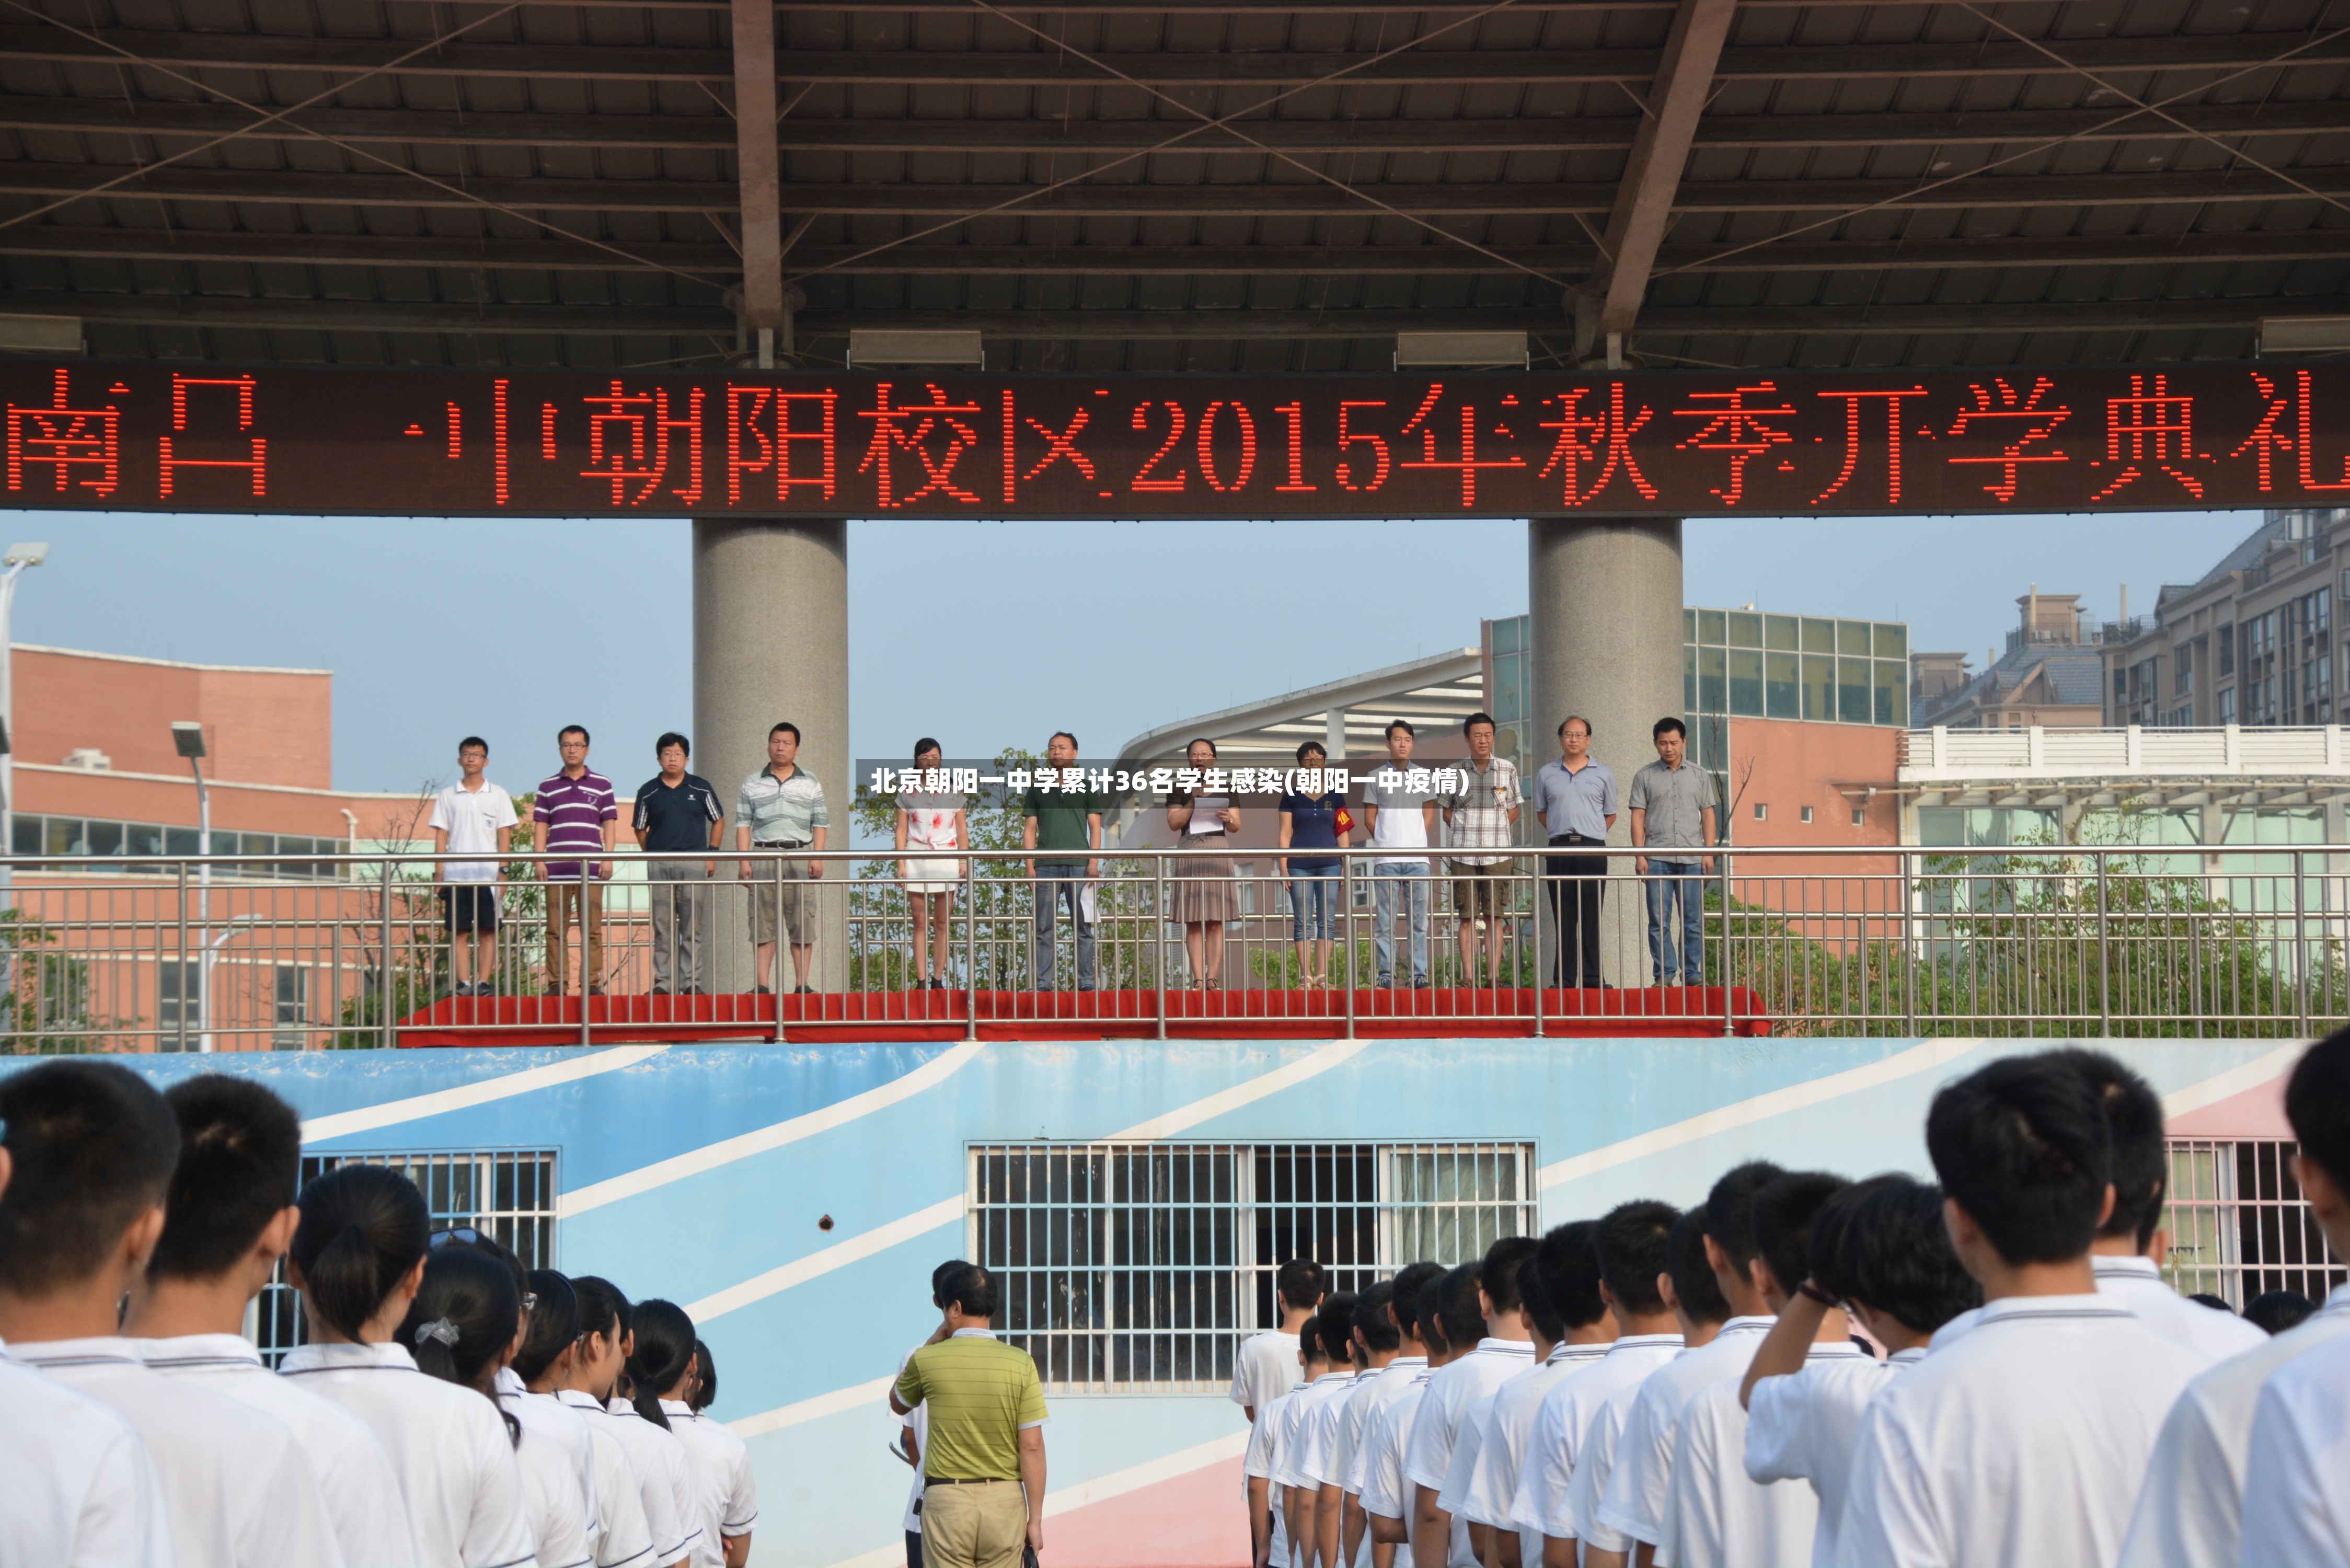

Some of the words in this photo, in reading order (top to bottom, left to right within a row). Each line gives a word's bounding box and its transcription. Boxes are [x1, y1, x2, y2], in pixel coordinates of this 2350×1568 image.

[7, 368, 2350, 508] 南昌小朝阳校区2015年秋季开学典礼
